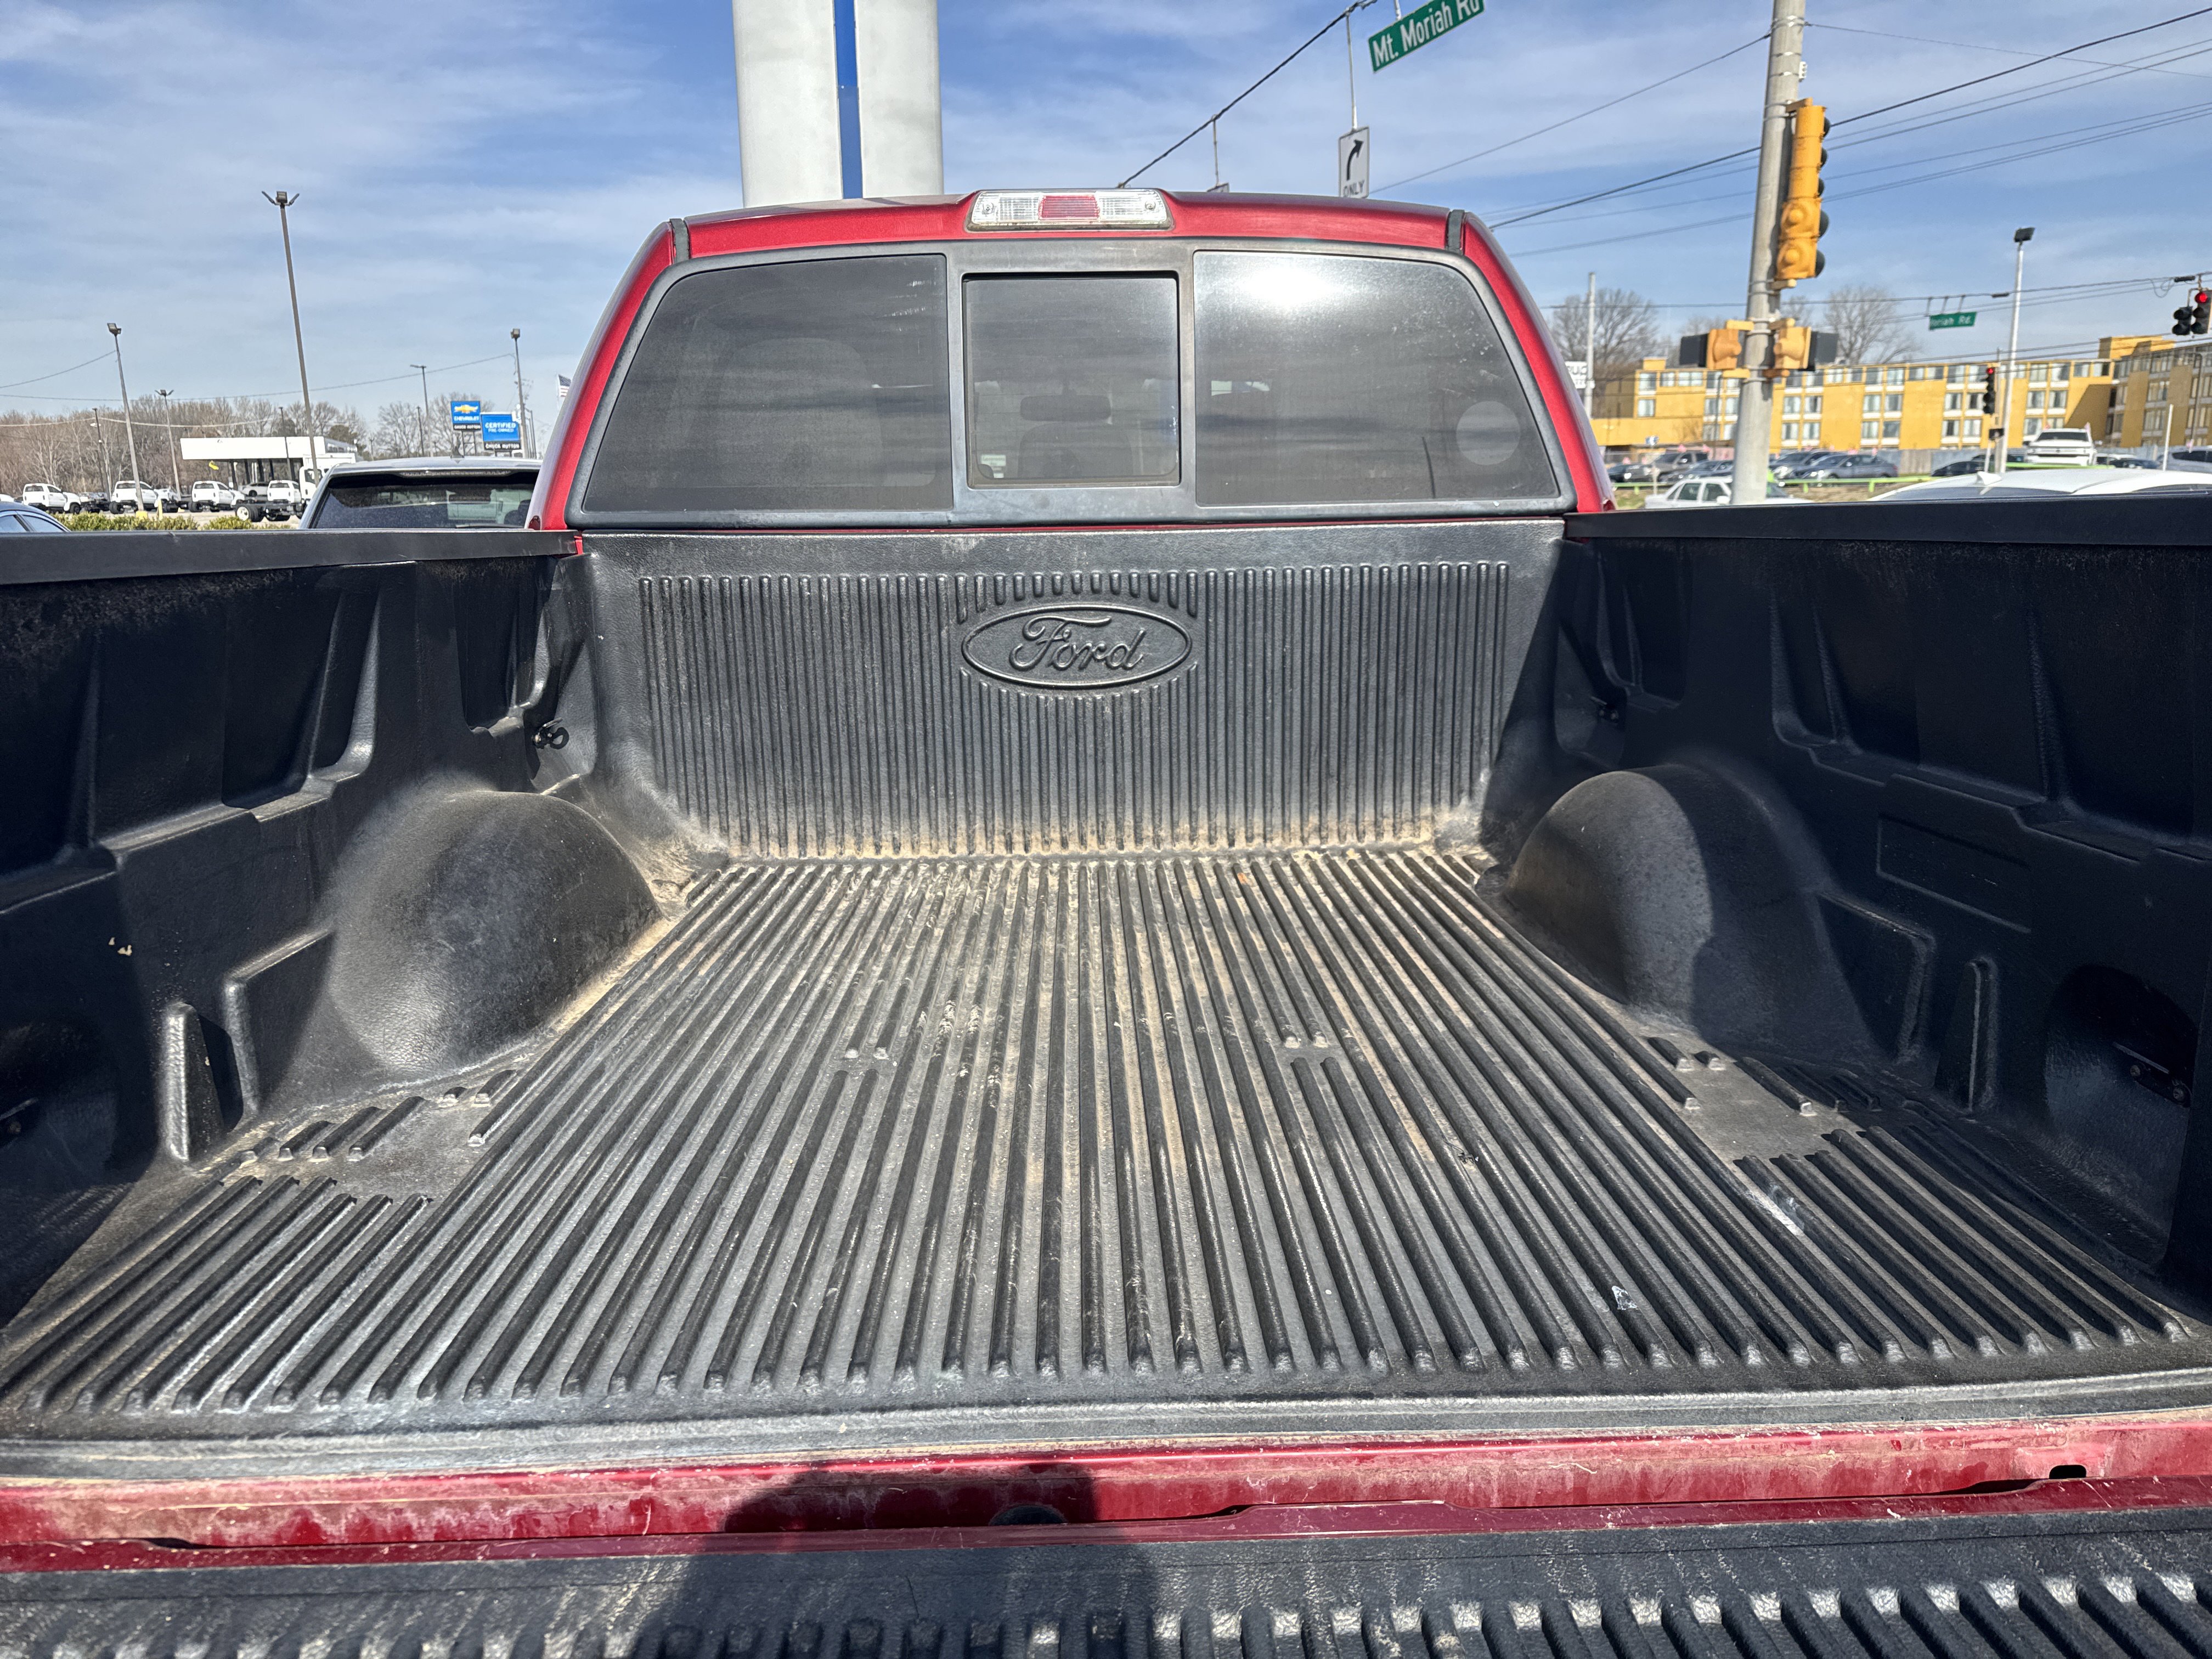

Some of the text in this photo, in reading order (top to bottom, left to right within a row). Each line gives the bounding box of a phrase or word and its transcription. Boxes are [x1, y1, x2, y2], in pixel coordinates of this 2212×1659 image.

[1373, 0, 1481, 67] Mt. Moriah Rd
[1343, 180, 1365, 197] ONLY
[1008, 614, 1146, 670] Ford
